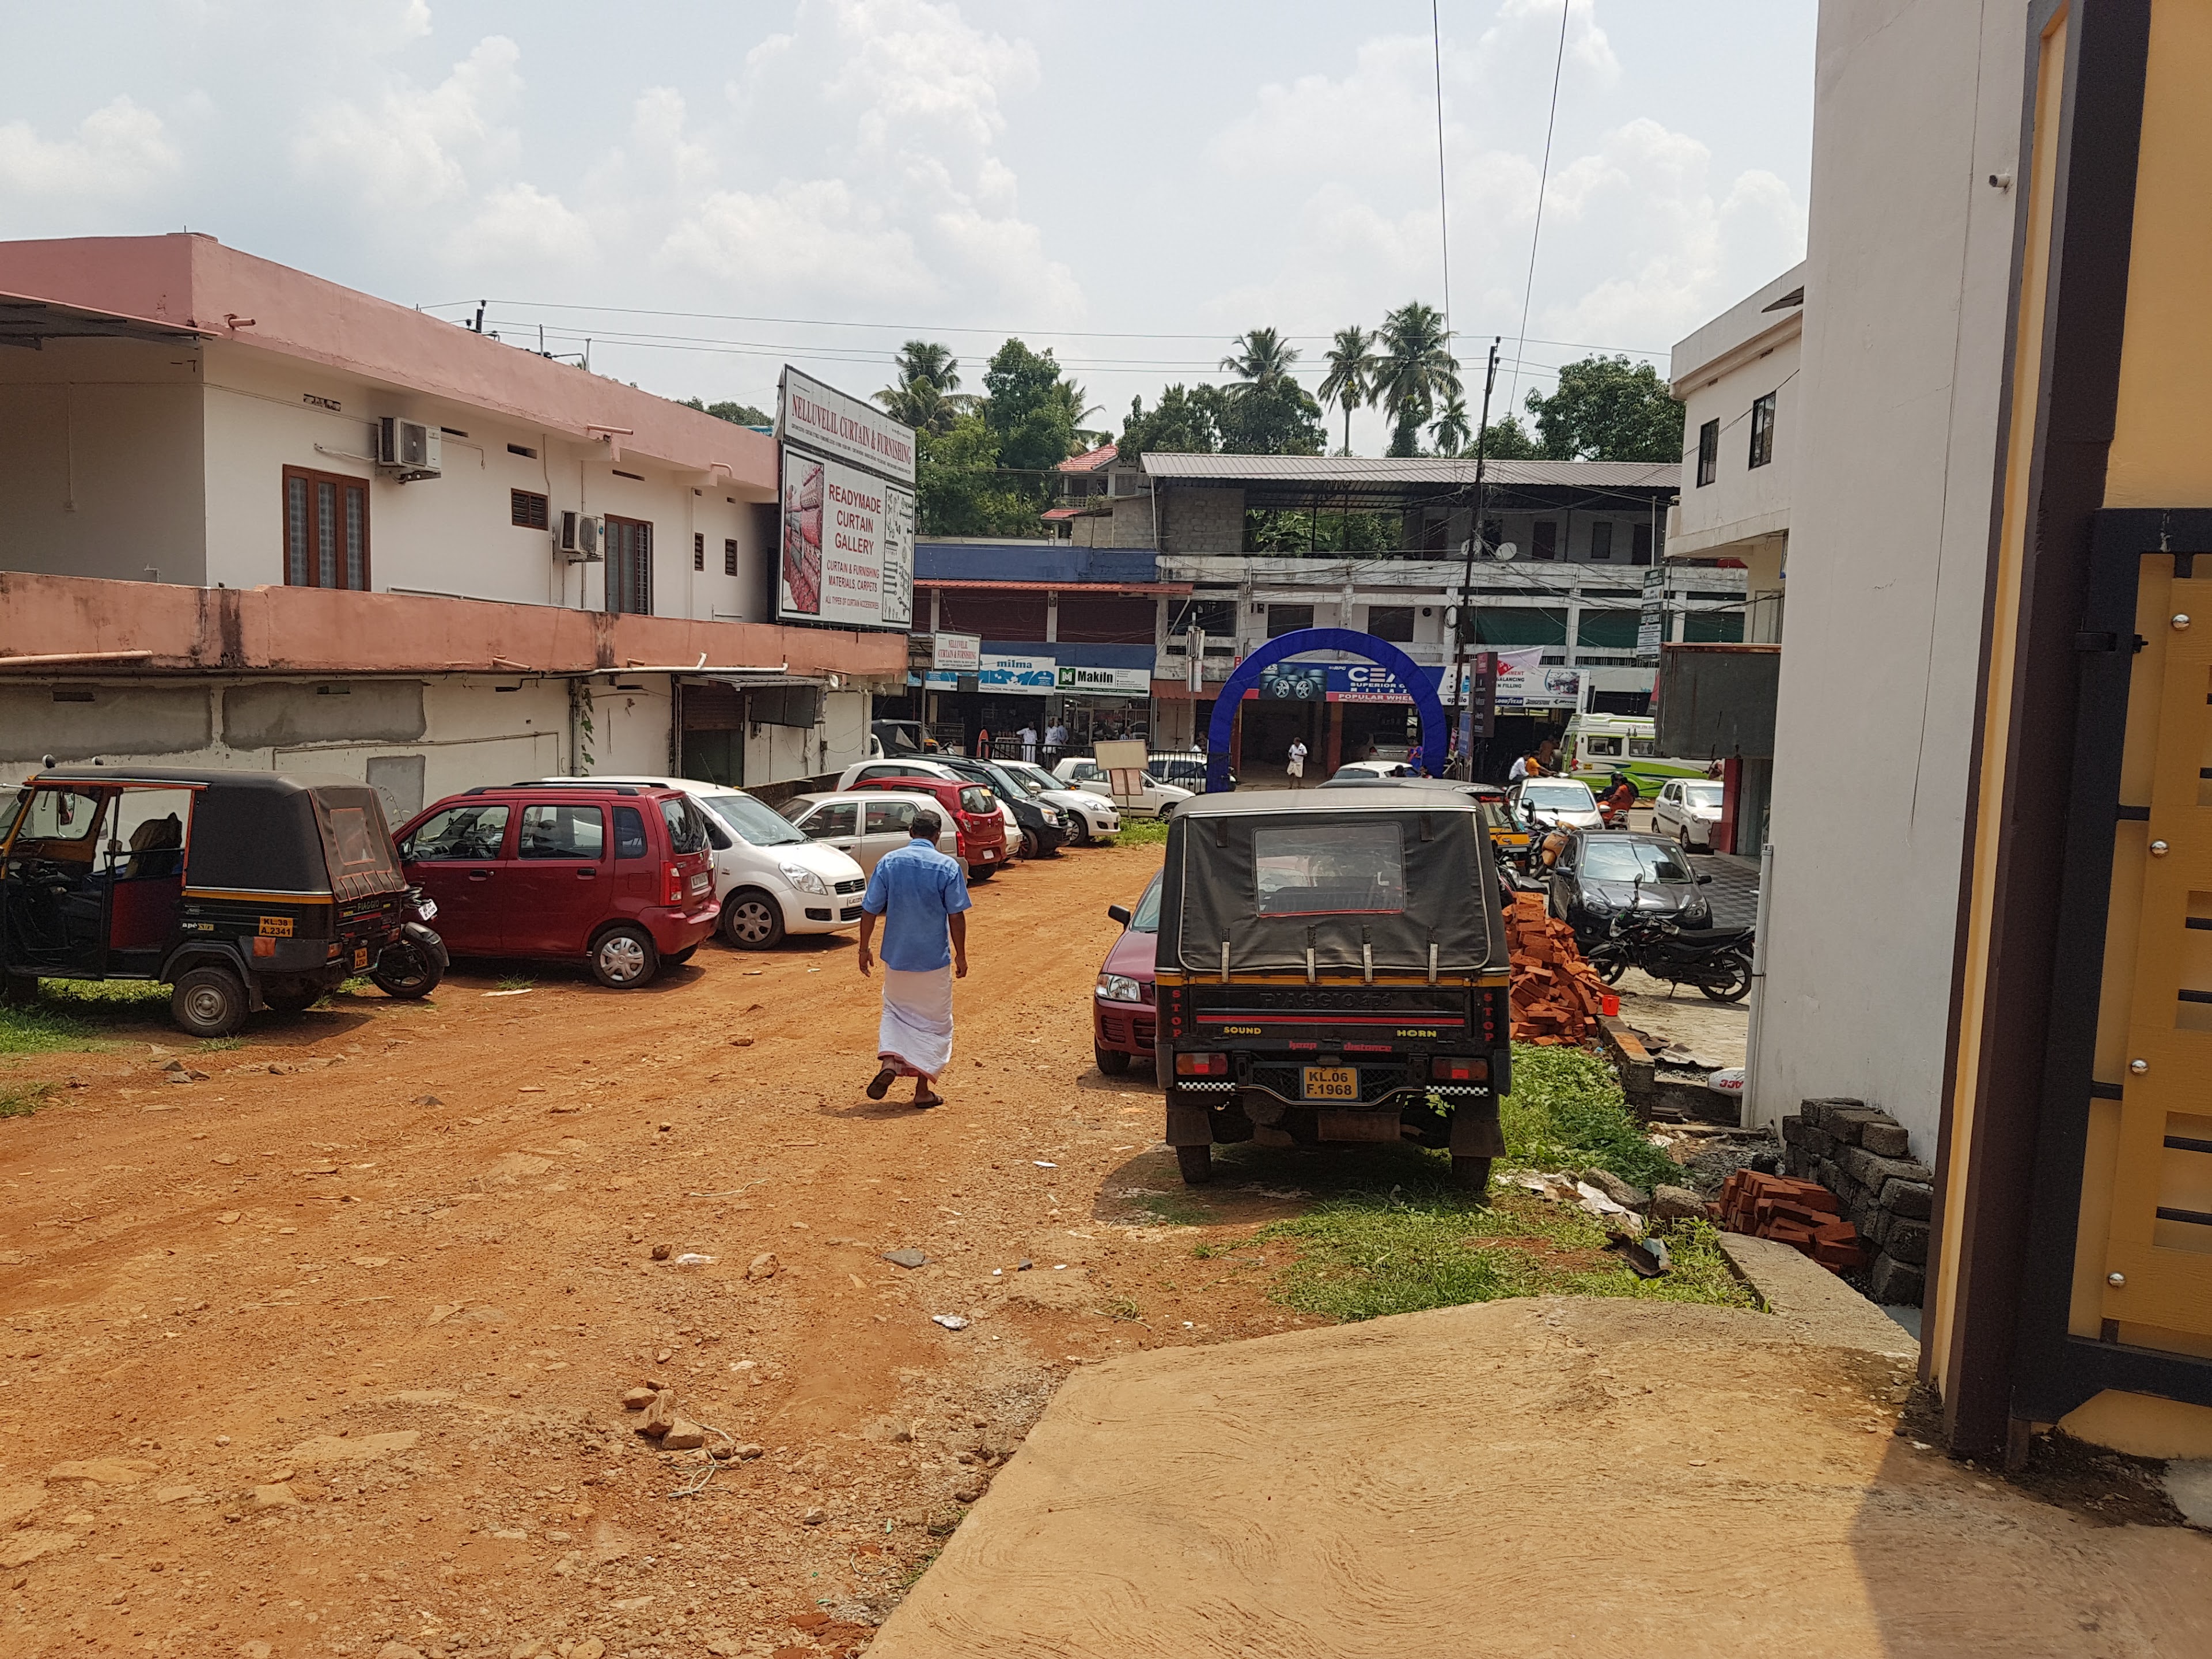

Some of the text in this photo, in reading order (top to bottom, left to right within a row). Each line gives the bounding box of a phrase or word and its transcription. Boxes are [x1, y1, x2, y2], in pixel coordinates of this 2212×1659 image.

[792, 394, 838, 434] NELLUVELIL
[840, 416, 870, 447] CURTAIN
[871, 430, 876, 450] &
[877, 433, 911, 465] FURNISHING
[829, 484, 881, 514] READYMADE
[837, 510, 873, 533] CURTAIN
[835, 533, 874, 555] GALLERY
[827, 559, 880, 578] CURTAIN & FURNISHING
[828, 575, 877, 592] MATERIALS, CARPETS
[997, 660, 1032, 668] milma
[357, 899, 380, 911] PIAGGIO
[263, 918, 288, 926] KL.38
[261, 927, 290, 935] A.2341
[1171, 990, 1182, 1037] STOP
[1483, 993, 1494, 1041] STOP
[1224, 1026, 1262, 1035] SOUND
[1396, 1029, 1437, 1037] HORN
[1289, 1040, 1392, 1053] keep distance
[1309, 1071, 1348, 1082] KL.06
[1306, 1084, 1352, 1096] F.1968
